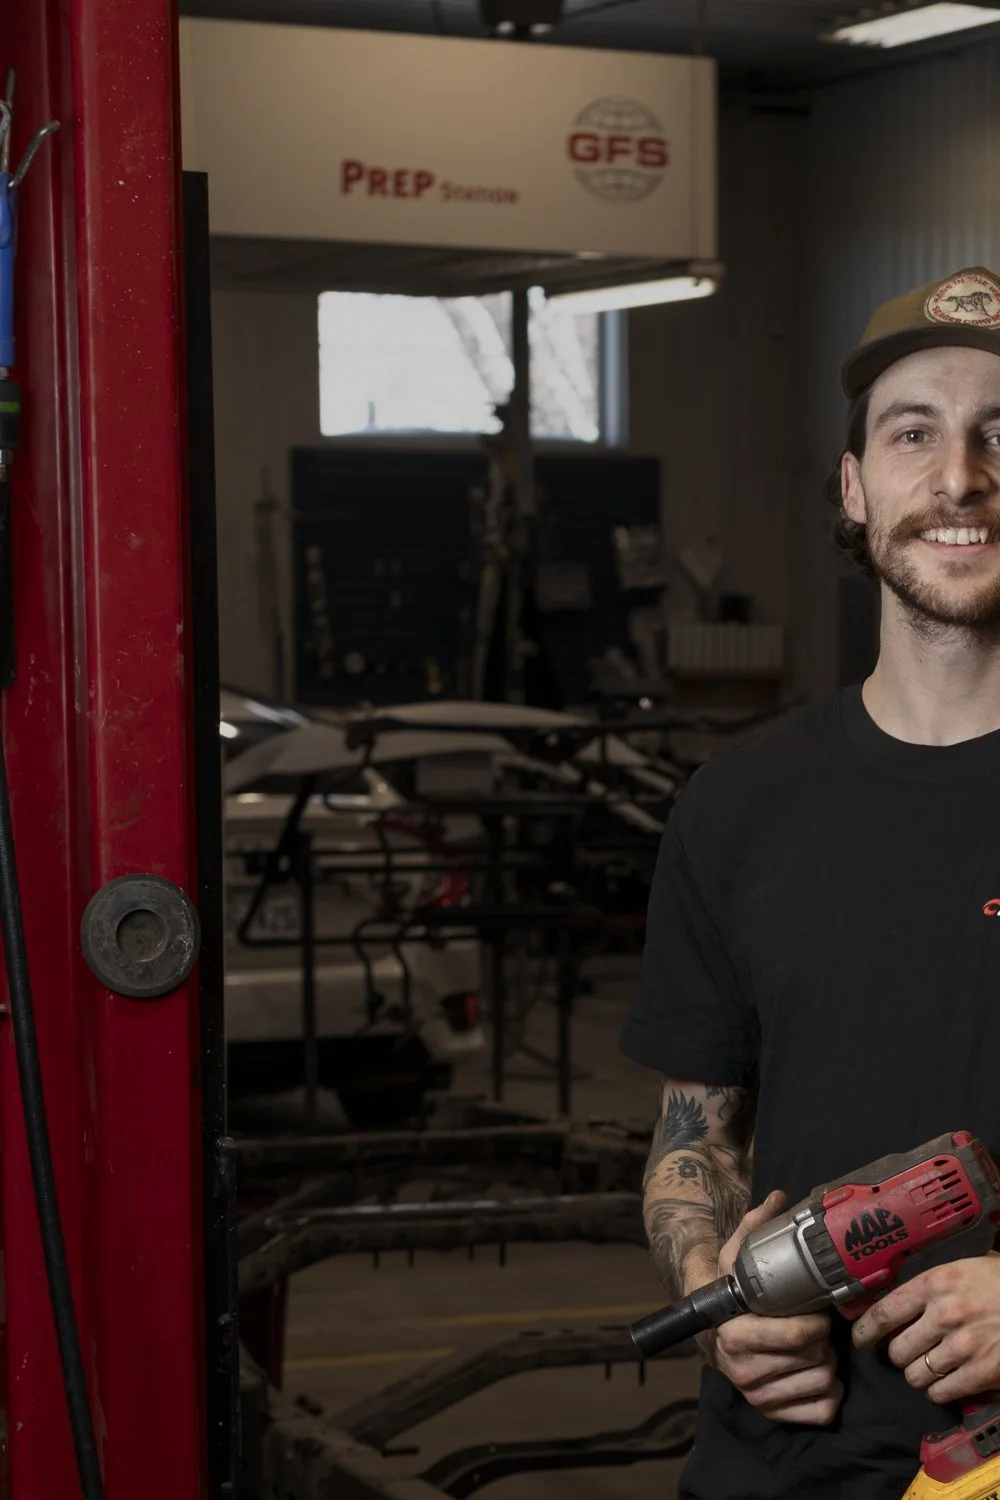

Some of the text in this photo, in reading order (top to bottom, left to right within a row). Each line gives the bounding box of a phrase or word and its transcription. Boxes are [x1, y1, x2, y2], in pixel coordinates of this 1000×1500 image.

[566, 132, 669, 168] GFS
[340, 159, 435, 199] PREP
[845, 1208, 904, 1252] MAC
[849, 1229, 909, 1261] TOOLS
